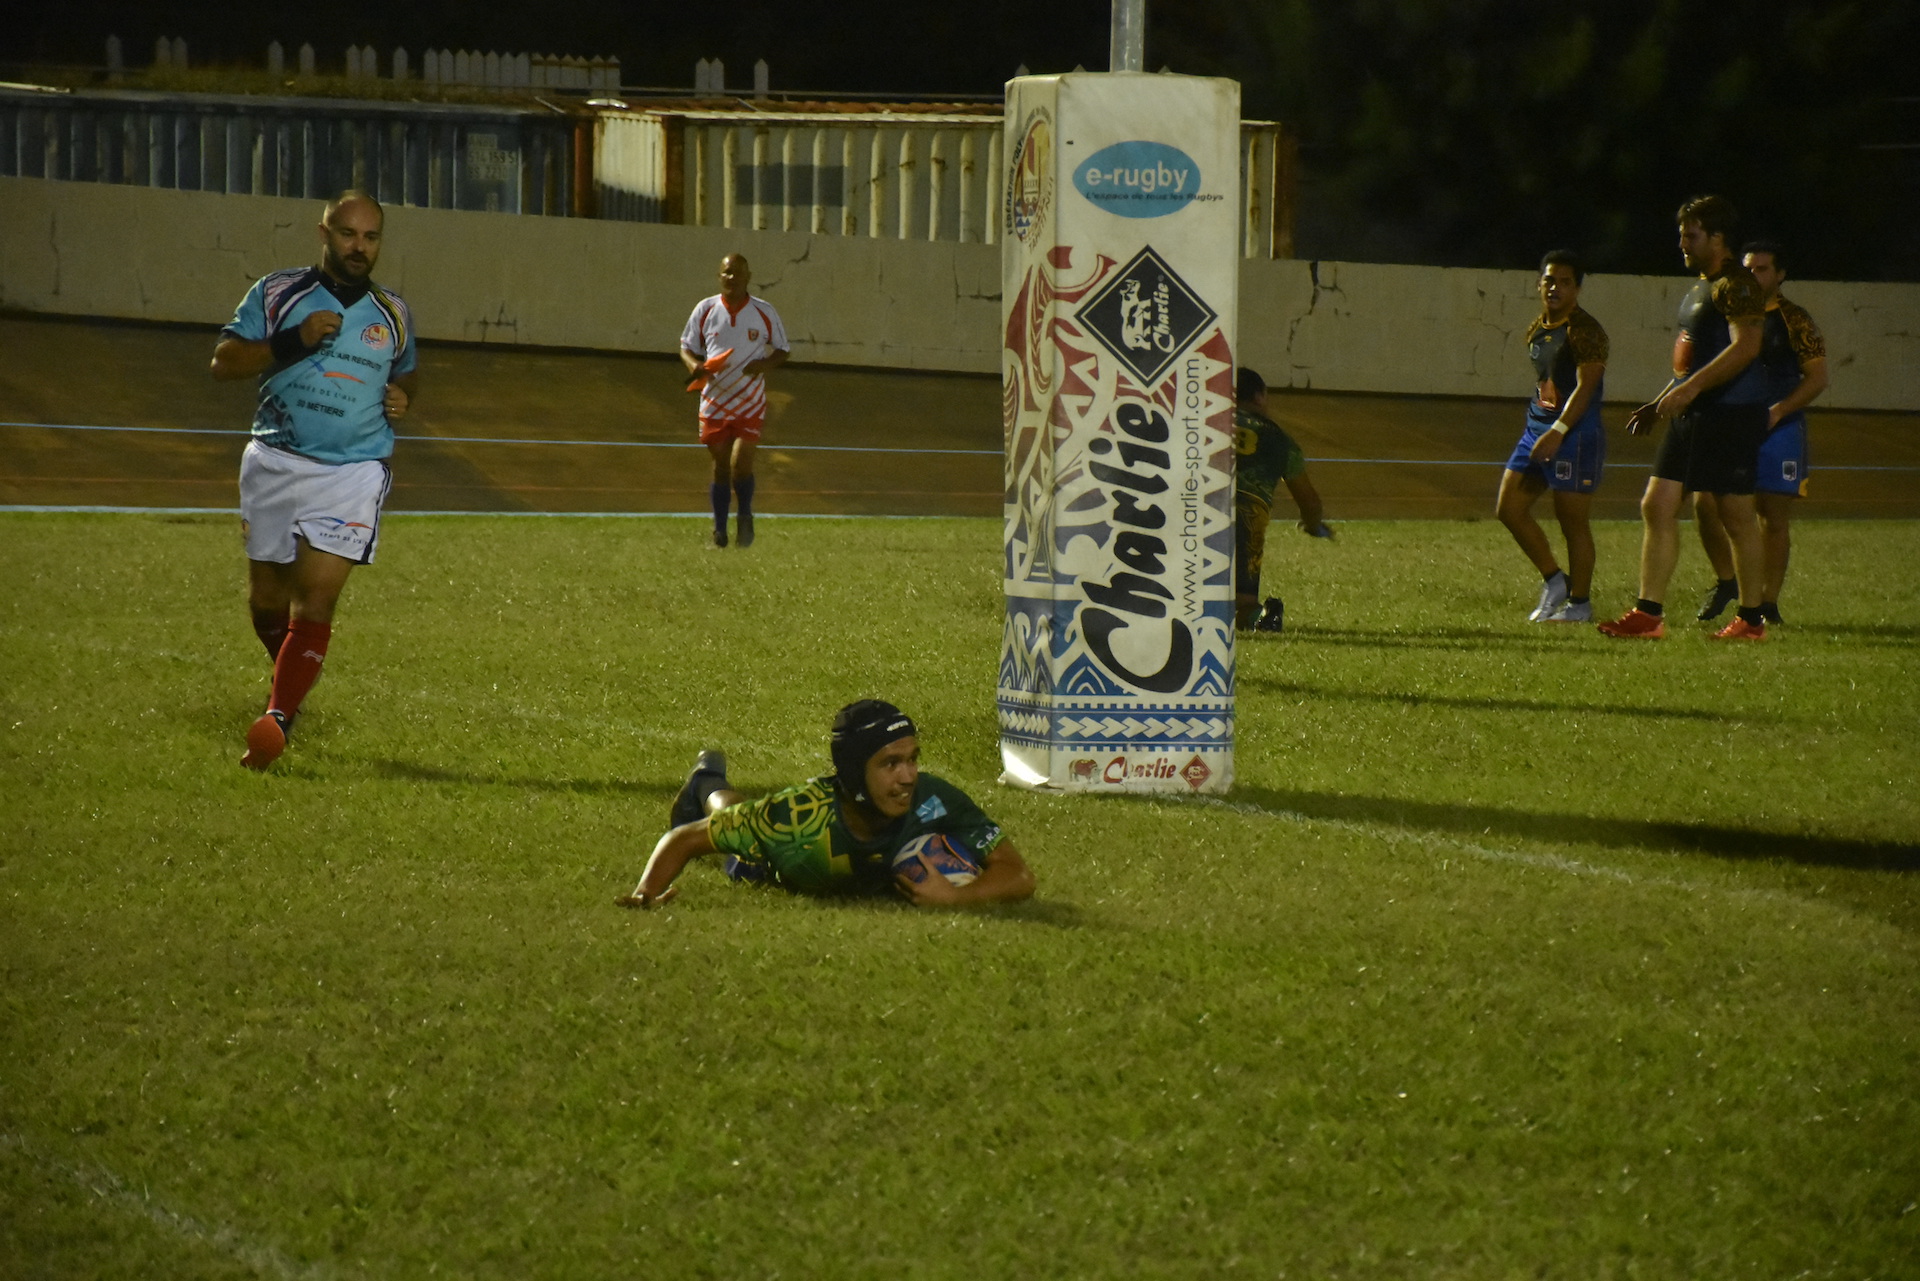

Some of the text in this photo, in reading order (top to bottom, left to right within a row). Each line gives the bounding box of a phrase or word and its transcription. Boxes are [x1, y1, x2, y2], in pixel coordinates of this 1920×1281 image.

[1085, 160, 1189, 193] e-rugby
[1086, 192, 1224, 203] L'espace de tous les Rugbys
[1152, 282, 1175, 353] Charlie
[1179, 358, 1200, 617] www.charlie-sport.com
[1079, 402, 1194, 694] Charlie
